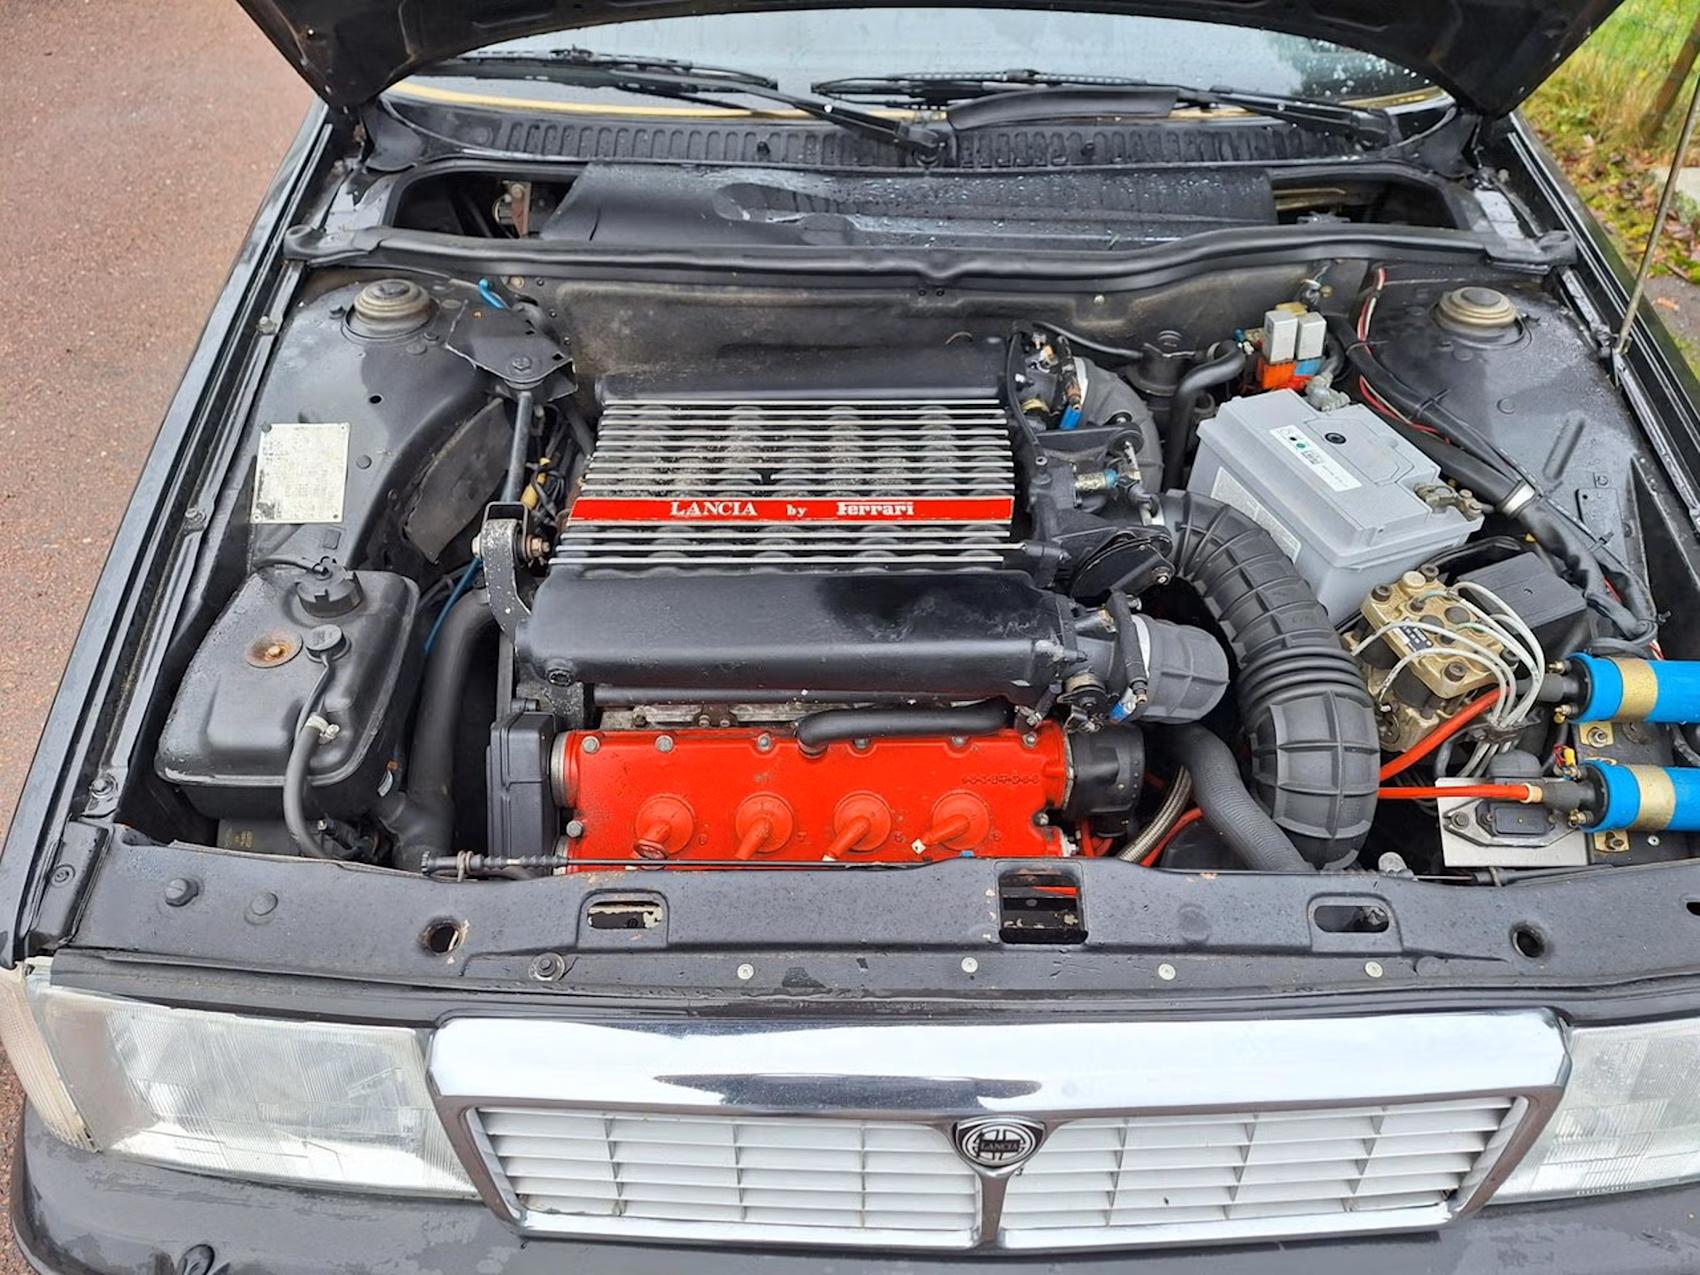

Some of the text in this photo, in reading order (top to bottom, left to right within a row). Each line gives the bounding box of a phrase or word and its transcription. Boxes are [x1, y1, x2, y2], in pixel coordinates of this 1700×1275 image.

[670, 501, 914, 517] LANCIA by Ferrari
[980, 1142, 1018, 1151] LANCIA
